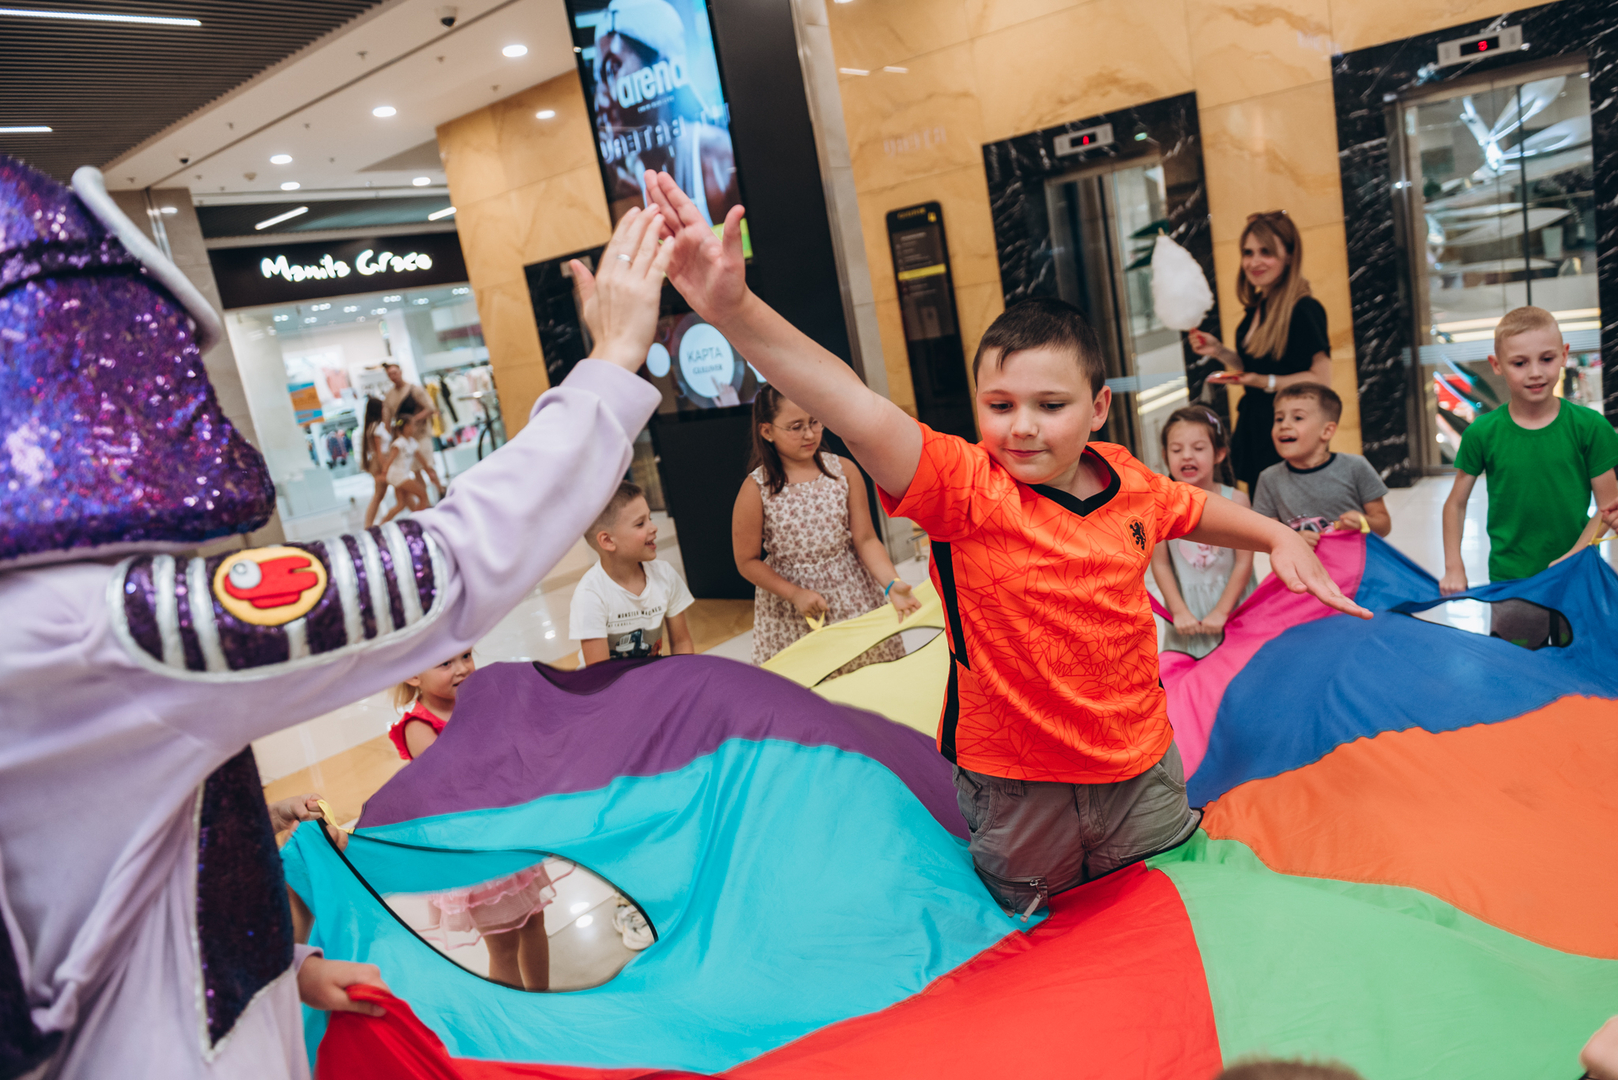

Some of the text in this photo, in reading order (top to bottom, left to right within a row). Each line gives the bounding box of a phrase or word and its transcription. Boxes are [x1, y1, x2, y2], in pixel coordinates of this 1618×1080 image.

[617, 57, 688, 109] arena
[260, 248, 433, 282] Manila Grace
[686, 346, 724, 363] КАРТА
